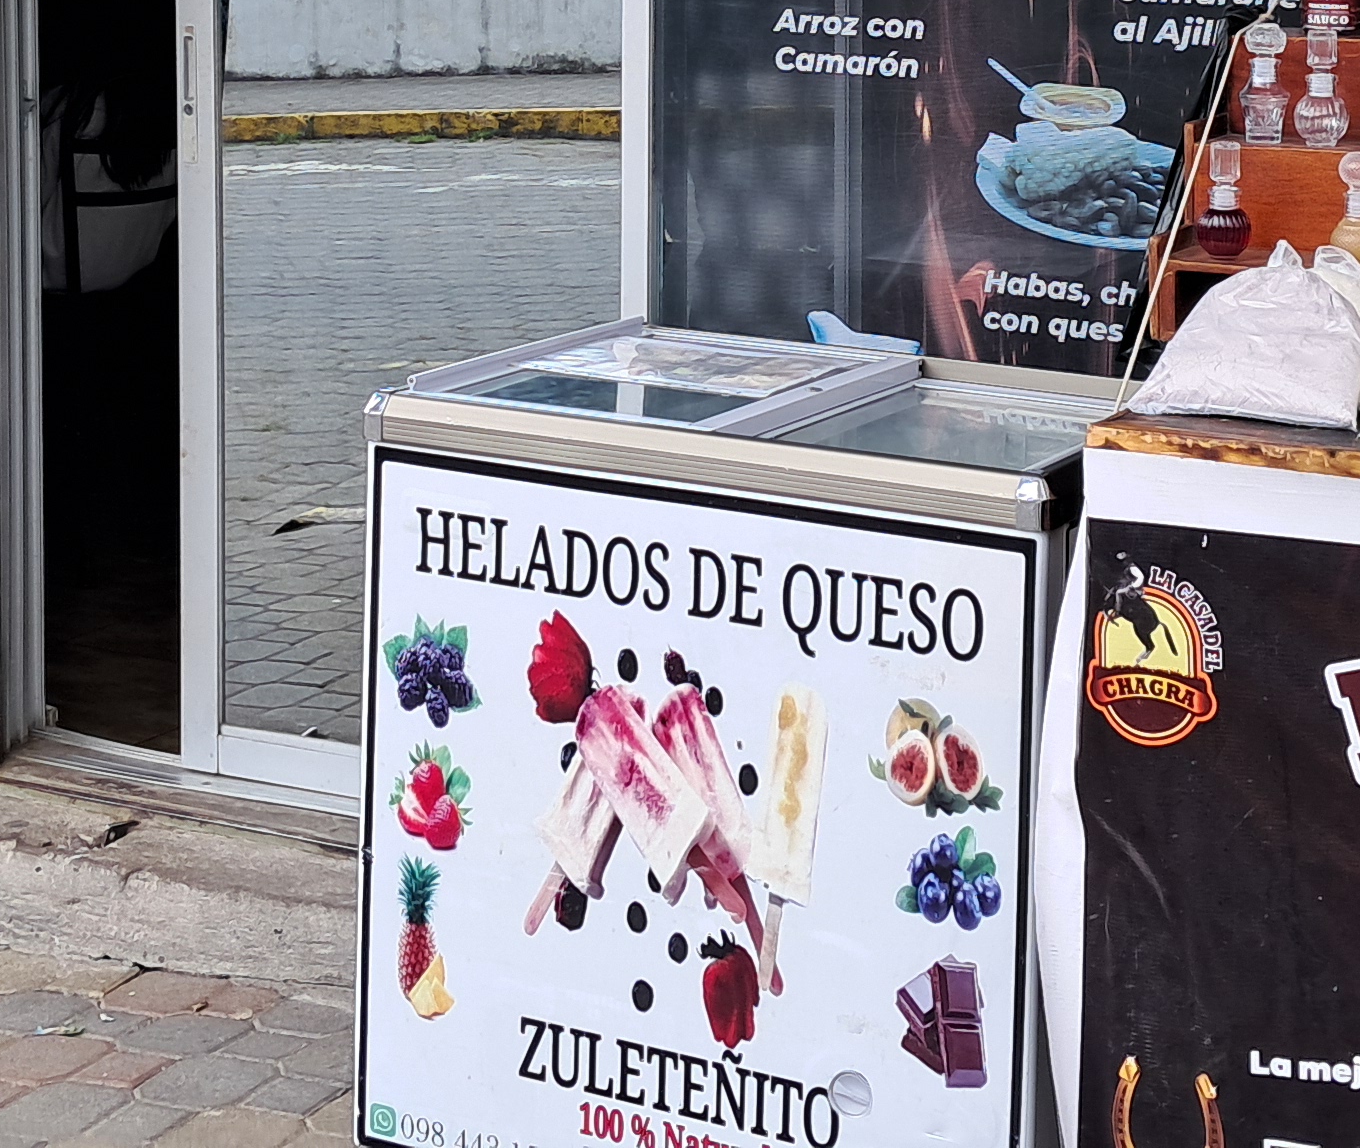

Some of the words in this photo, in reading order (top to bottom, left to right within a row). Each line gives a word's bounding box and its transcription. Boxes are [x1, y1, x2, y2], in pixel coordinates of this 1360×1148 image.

[773, 8, 858, 38] Arroz
[867, 14, 924, 40] con
[1114, 17, 1147, 43] al
[1153, 16, 1218, 52] Ajill
[1307, 14, 1350, 25] SAUCO
[775, 47, 920, 79] Camarón
[984, 270, 1091, 305] Habas,
[1100, 273, 1136, 307] ch
[983, 309, 1038, 336] con
[1047, 315, 1124, 344] ques
[416, 506, 670, 612] HELADOS
[687, 547, 764, 628] DE
[782, 561, 983, 662] QUESO
[1148, 565, 1177, 593] LA
[1174, 581, 1219, 632] CASA
[1202, 630, 1223, 673] DEL
[1101, 677, 1197, 709] CHAGRA
[1249, 1050, 1292, 1077] La
[518, 1016, 840, 1148] ZULETEÑITO
[400, 1113, 446, 1148] 098
[579, 1101, 625, 1144] 100
[631, 1113, 656, 1148] %
